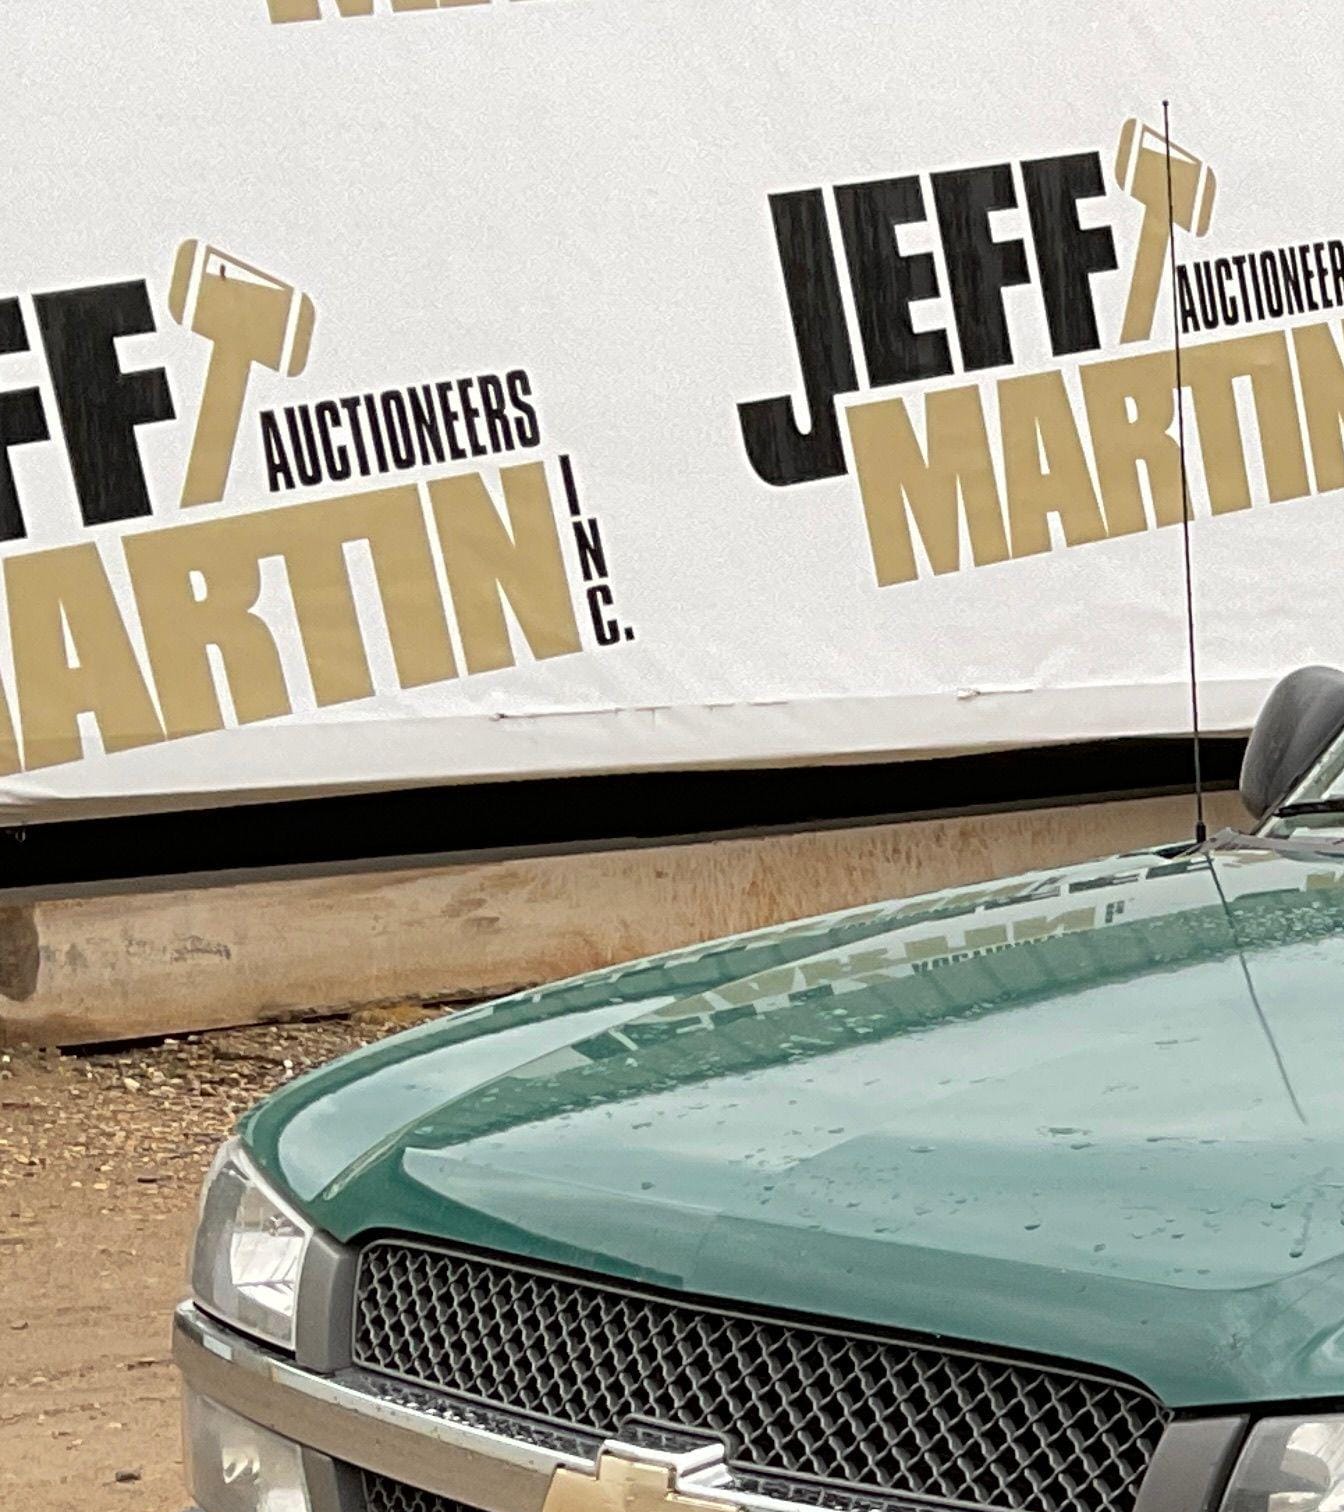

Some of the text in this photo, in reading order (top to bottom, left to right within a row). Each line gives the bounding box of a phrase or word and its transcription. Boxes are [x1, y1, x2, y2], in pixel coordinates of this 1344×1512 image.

[259, 369, 541, 492] AUCTIONEERS
[737, 151, 1119, 487] JEFF
[0, 460, 583, 777] ARTIN
[559, 454, 634, 646] INC.
